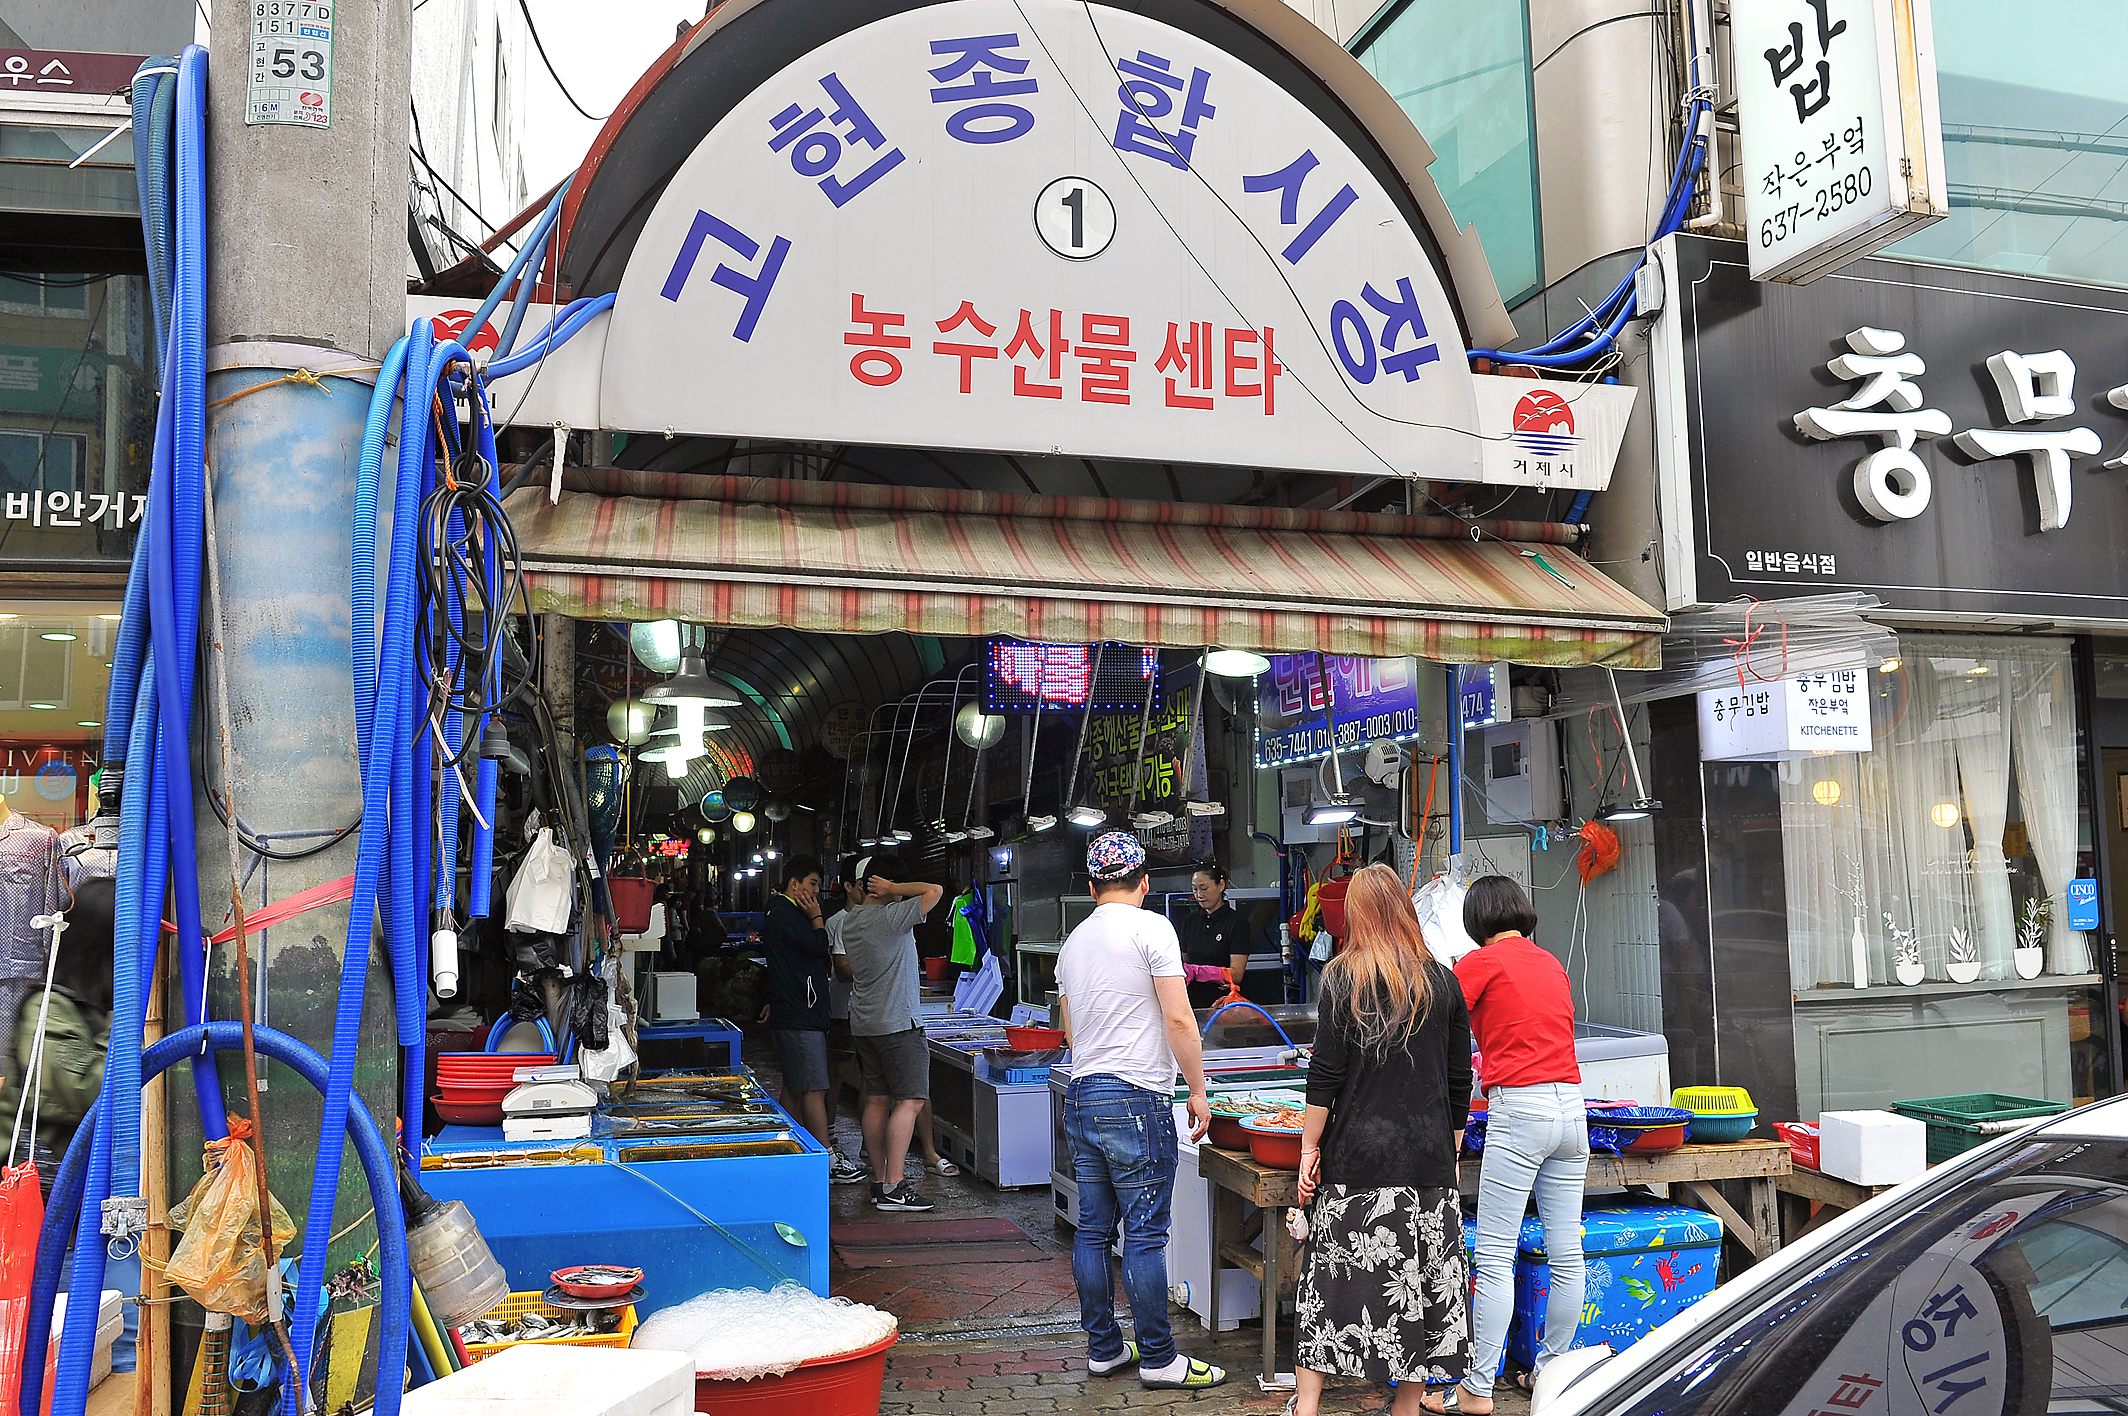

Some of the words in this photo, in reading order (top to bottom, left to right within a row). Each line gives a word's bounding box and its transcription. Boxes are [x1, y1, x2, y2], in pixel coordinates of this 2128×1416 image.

[256, 2, 330, 20] 8377D
[256, 20, 294, 34] 151
[255, 42, 266, 83] 고현간
[271, 48, 326, 81] 53
[1763, 0, 1848, 125] 밥
[252, 102, 279, 113] 16M
[312, 113, 329, 124] 123
[660, 32, 1441, 386] 고현종합시장
[1760, 166, 1872, 248] 637-2580
[843, 292, 1138, 407] 농수산물
[1154, 319, 1283, 416] 센타
[1793, 326, 2128, 533] 충무
[1513, 458, 1575, 479] 거제시
[1744, 548, 1838, 576] 일반음식점
[1713, 691, 1770, 722] 충무김밥
[1800, 725, 1859, 736] KITCHENETTE
[2070, 883, 2095, 896] CESCO
